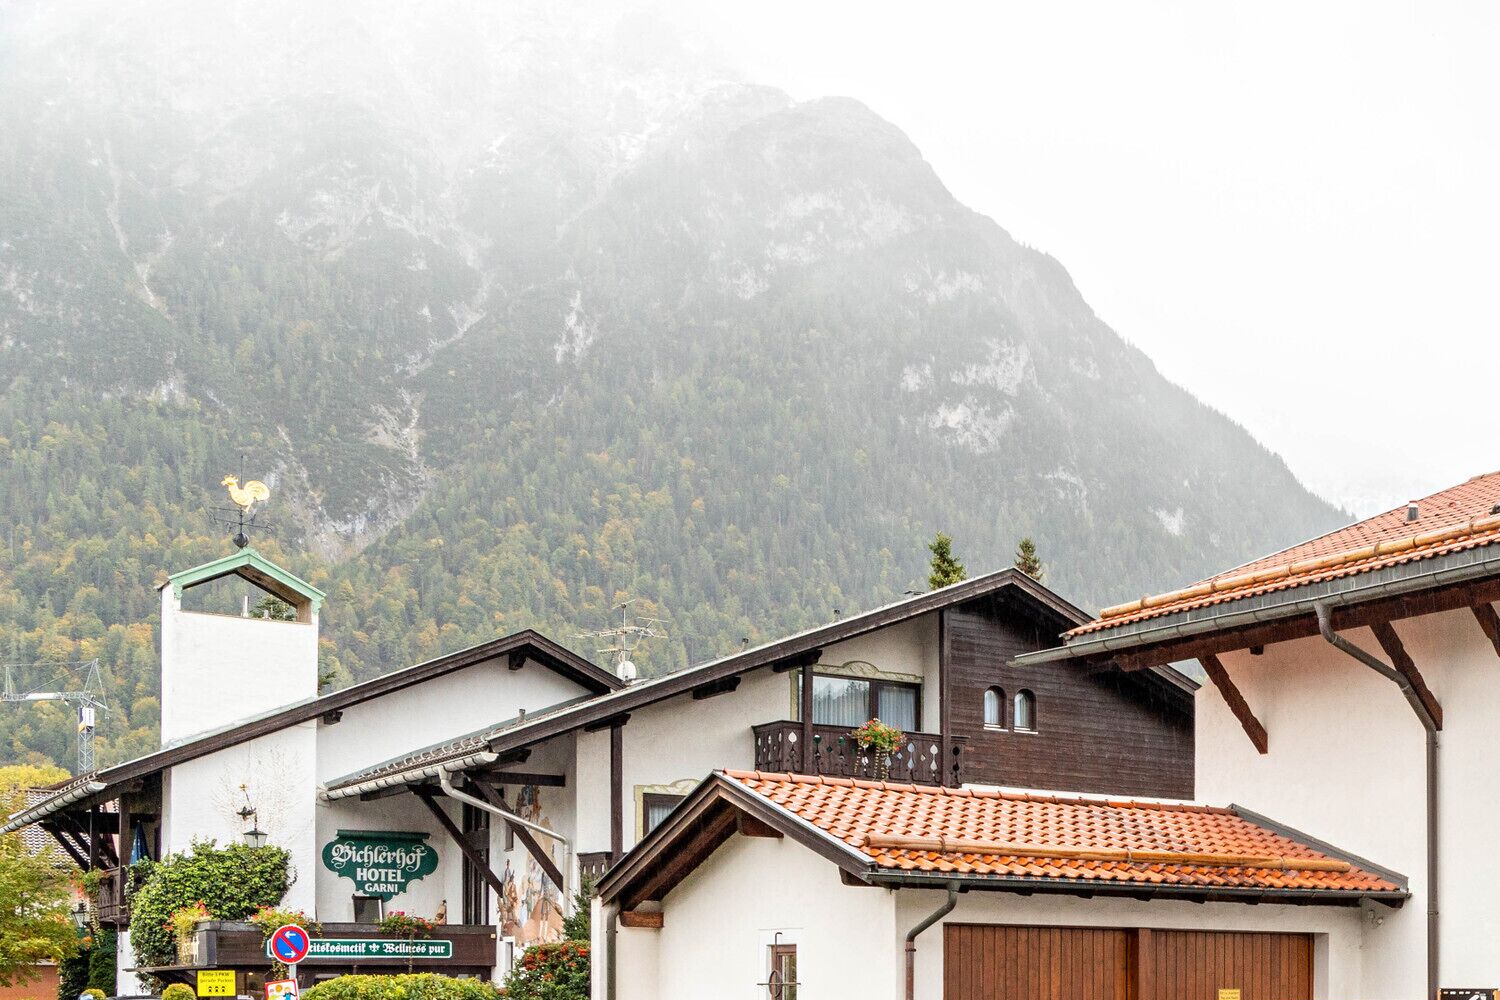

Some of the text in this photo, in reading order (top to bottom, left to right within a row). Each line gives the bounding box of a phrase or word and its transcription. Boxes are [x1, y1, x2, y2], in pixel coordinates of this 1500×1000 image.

[331, 842, 427, 872] Bichlerhof
[356, 868, 405, 882] HOTEL
[364, 883, 398, 893] GARNI
[382, 943, 427, 954] Wellness
[429, 945, 446, 955] pur
